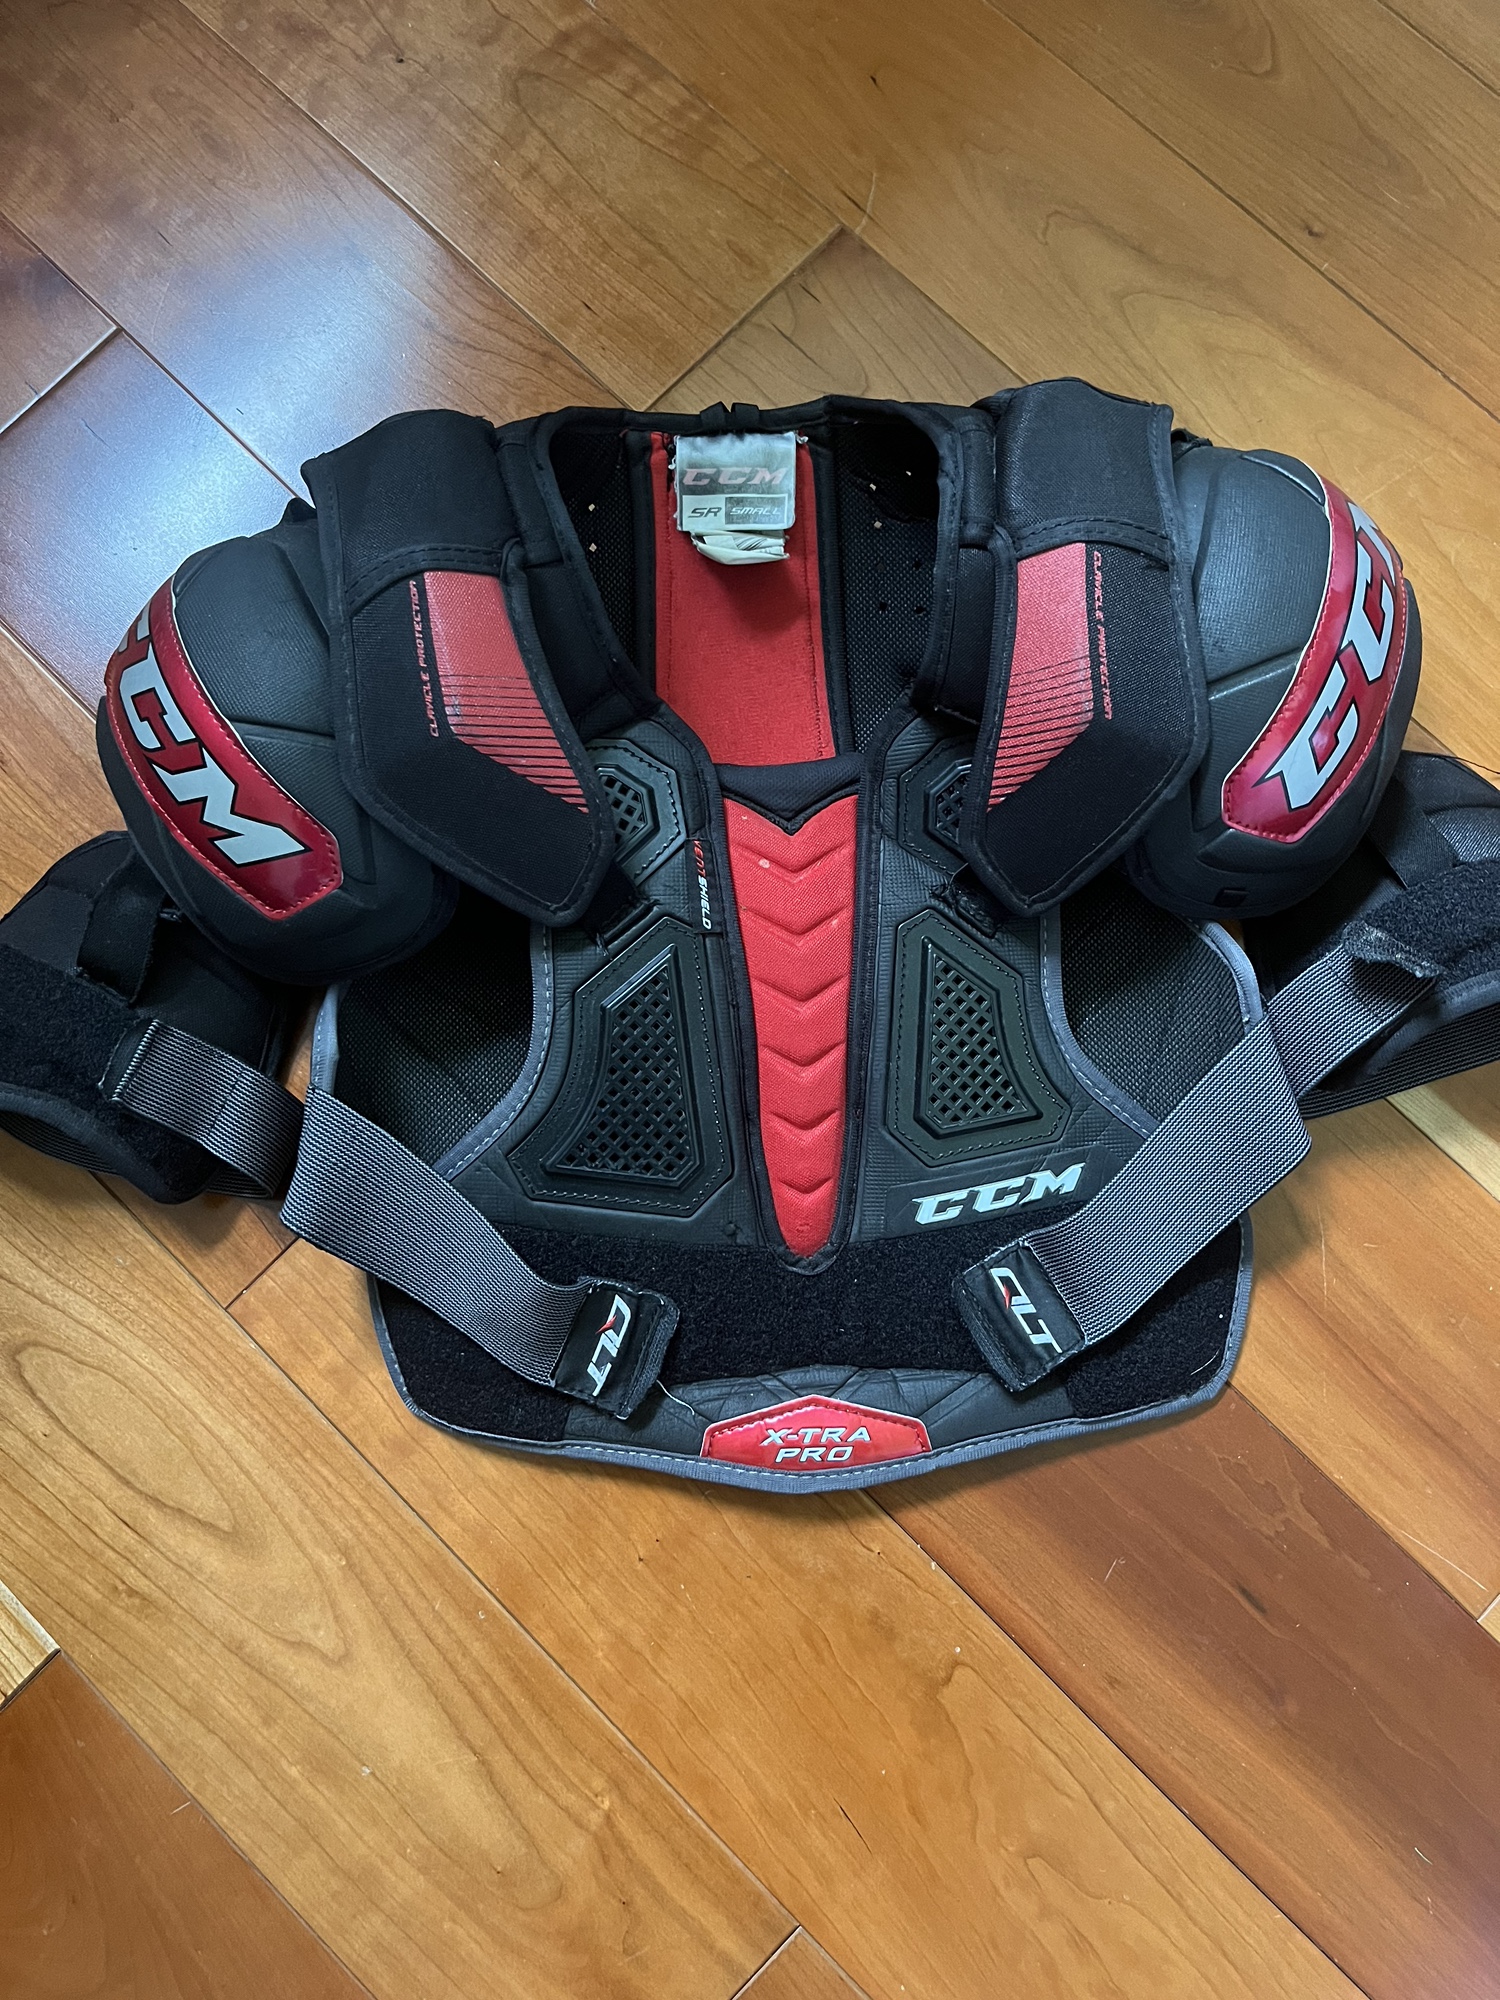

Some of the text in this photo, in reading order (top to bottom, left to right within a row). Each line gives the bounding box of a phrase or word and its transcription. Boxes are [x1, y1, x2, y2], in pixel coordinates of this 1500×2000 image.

[682, 467, 788, 485] CCM
[688, 506, 782, 518] SR SMALL
[409, 580, 440, 737] CLAVICLE PROTECTION
[911, 1162, 1086, 1225] CCM
[760, 1426, 871, 1446] X-TRA
[774, 1446, 854, 1463] PRO
